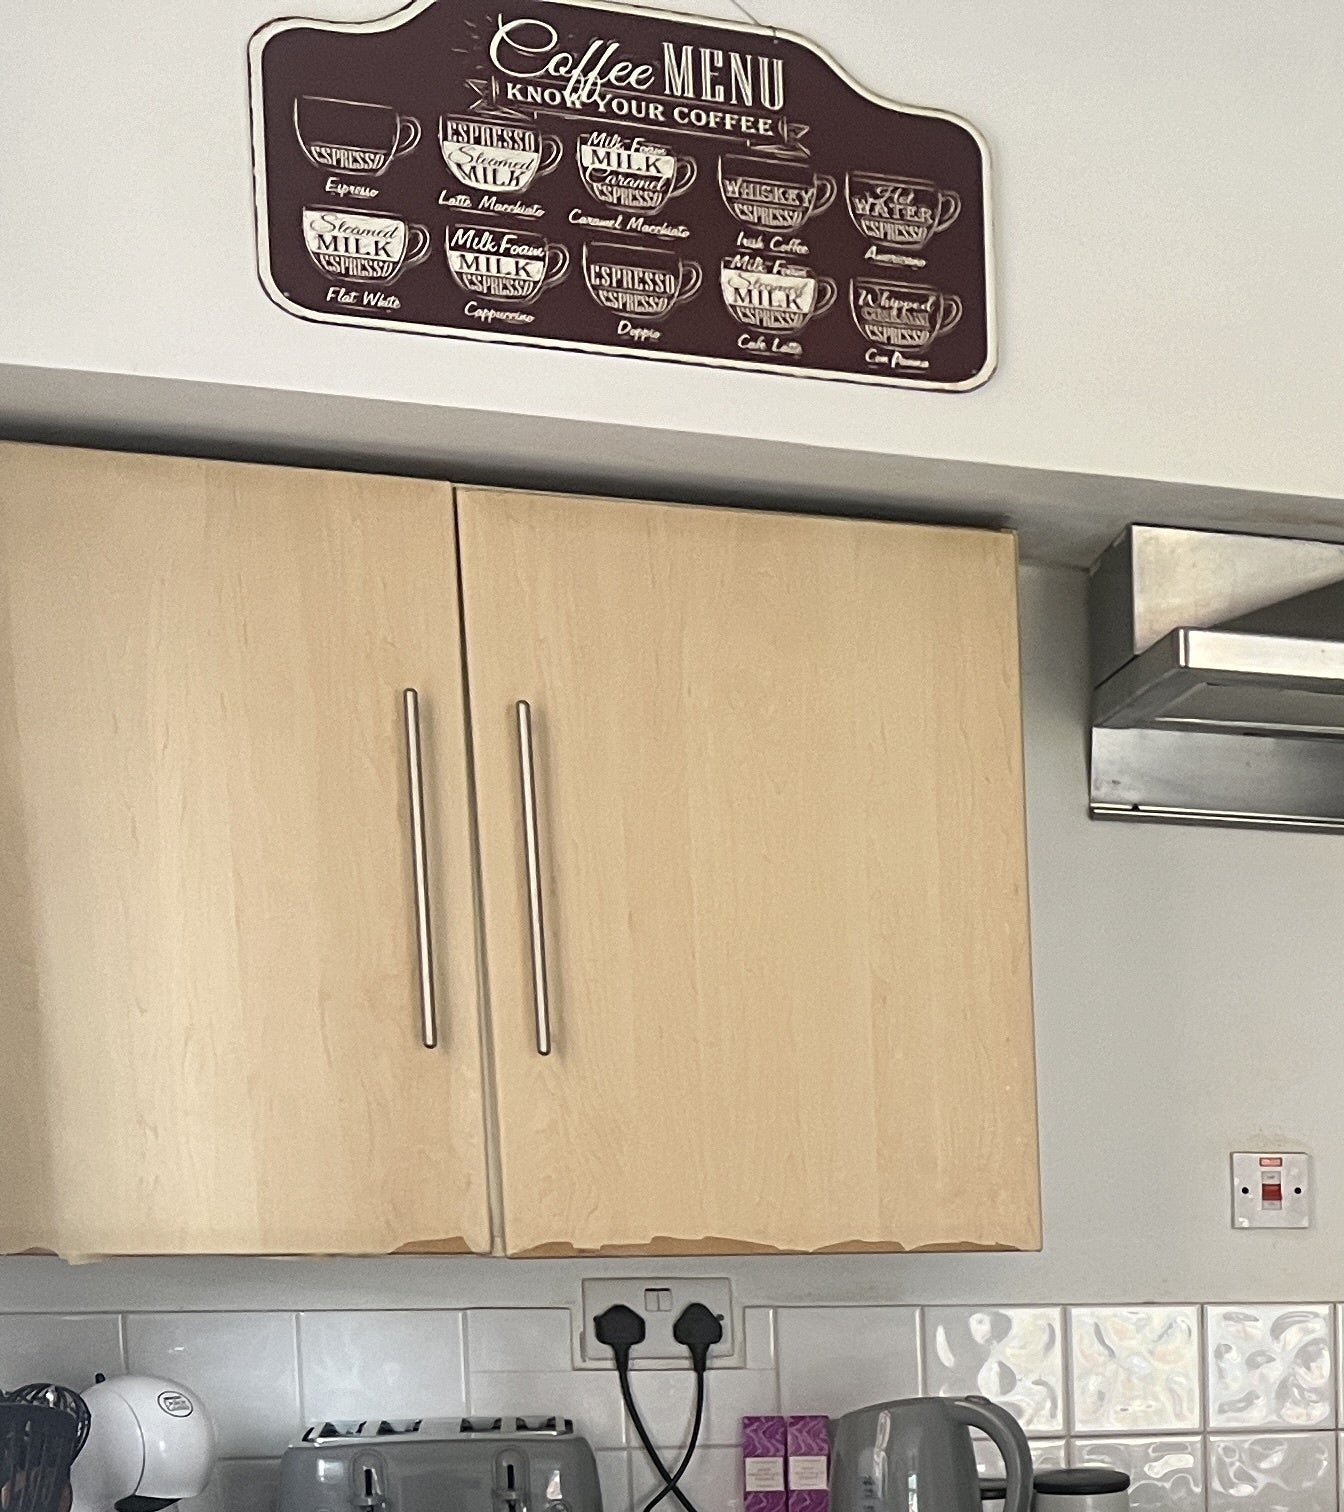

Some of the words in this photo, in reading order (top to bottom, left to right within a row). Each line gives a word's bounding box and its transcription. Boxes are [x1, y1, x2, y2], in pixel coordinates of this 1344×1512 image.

[490, 14, 655, 102] Coffee
[663, 42, 784, 110] MENU
[507, 82, 582, 109] KNOW
[597, 95, 666, 121] YOUR
[673, 107, 775, 136] COFFEE
[447, 121, 535, 151] ESPRESSO
[588, 131, 625, 151] Milk
[311, 147, 385, 169] ESPRESSO
[448, 146, 535, 170] Steamed
[591, 149, 662, 174] MILK
[456, 162, 527, 187] MILK
[586, 166, 666, 192] Caramel
[325, 177, 380, 198] Espresso
[593, 182, 662, 207] ESPRESSO
[723, 178, 814, 207] WHISKEY
[438, 190, 473, 208] Latte
[478, 195, 546, 216] Macchiato
[734, 203, 803, 227] ESPRESSO
[853, 193, 933, 223] WATER
[310, 214, 398, 239] Steamed
[862, 219, 928, 242] ESPRESSO
[316, 233, 395, 258] MILK
[450, 228, 497, 251] Milk
[499, 235, 545, 257] Foam
[319, 254, 394, 278] ESPRESSO
[458, 254, 540, 278] MILK
[463, 274, 534, 296] ESPRESSO
[590, 264, 676, 294] ESPRESSO
[326, 287, 357, 304] Flat
[363, 291, 401, 309] White
[599, 289, 668, 313] ESPRESSO
[734, 288, 803, 310] MILK
[858, 290, 936, 313] Whipped
[737, 307, 803, 329] ESPRESSO
[865, 324, 930, 346] ESPRESSO
